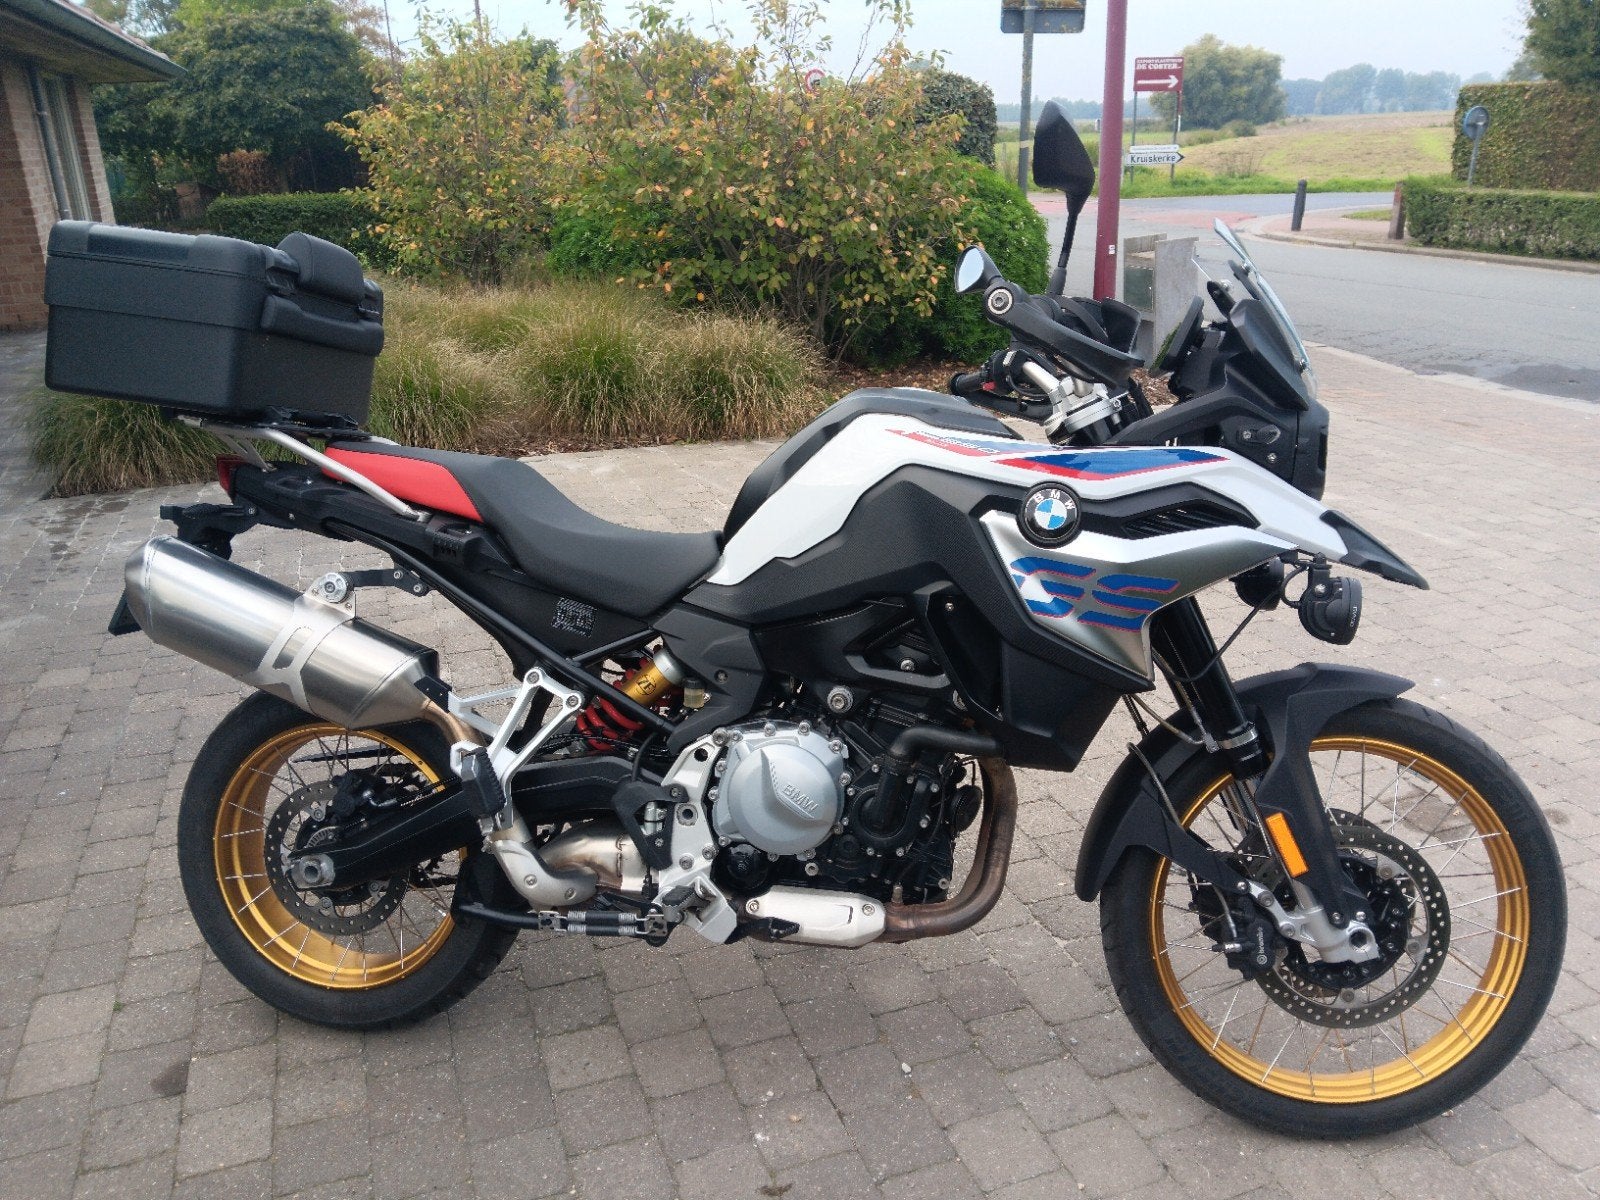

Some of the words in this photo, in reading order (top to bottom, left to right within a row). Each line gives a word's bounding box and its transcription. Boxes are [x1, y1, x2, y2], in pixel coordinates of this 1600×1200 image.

[1130, 155, 1176, 163] Kruiskerke
[1033, 489, 1075, 509] BMW
[783, 784, 818, 811] BMW
